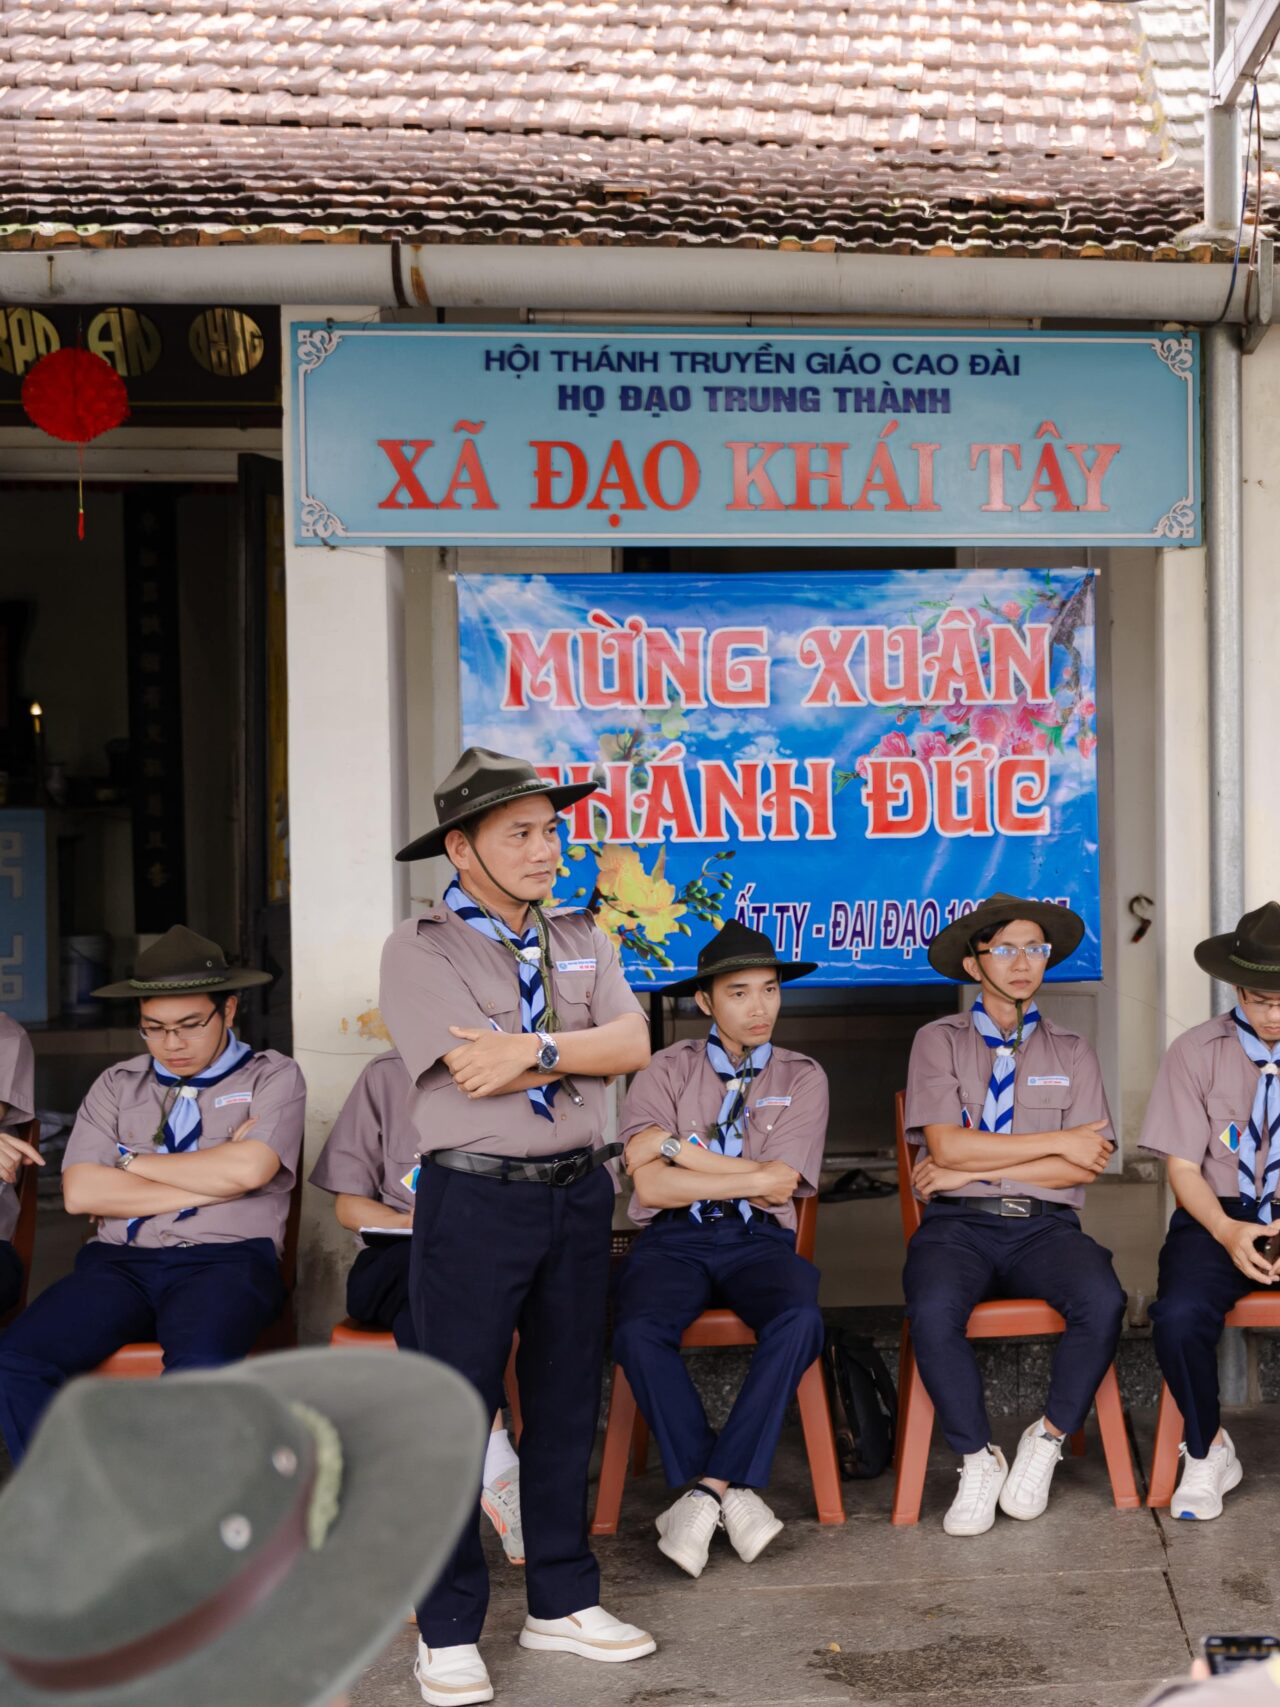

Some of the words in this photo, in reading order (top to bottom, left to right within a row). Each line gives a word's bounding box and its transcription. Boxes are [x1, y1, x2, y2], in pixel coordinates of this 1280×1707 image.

[484, 343, 540, 379] HỘI
[550, 344, 659, 373] THÁNH
[670, 342, 795, 374] TRUYỀN
[805, 346, 881, 375] GIÁO
[892, 353, 959, 376] CAO
[969, 347, 1020, 376] ĐÀI
[557, 385, 605, 417] HỌ
[619, 385, 692, 417] ĐẠO
[703, 386, 821, 413] TRUNG
[833, 380, 951, 414] THÀNH
[376, 419, 498, 510] XÃ
[528, 439, 701, 528] ĐẠO
[725, 420, 942, 512] KHÁI
[970, 420, 1121, 512] TÂY
[503, 608, 771, 711] MỪNG
[799, 607, 1053, 708] XUÂN
[862, 740, 1050, 839] ĐỨC
[773, 902, 811, 962] TỴ
[830, 899, 875, 961] ĐẠI
[881, 899, 941, 959] ĐẠO
